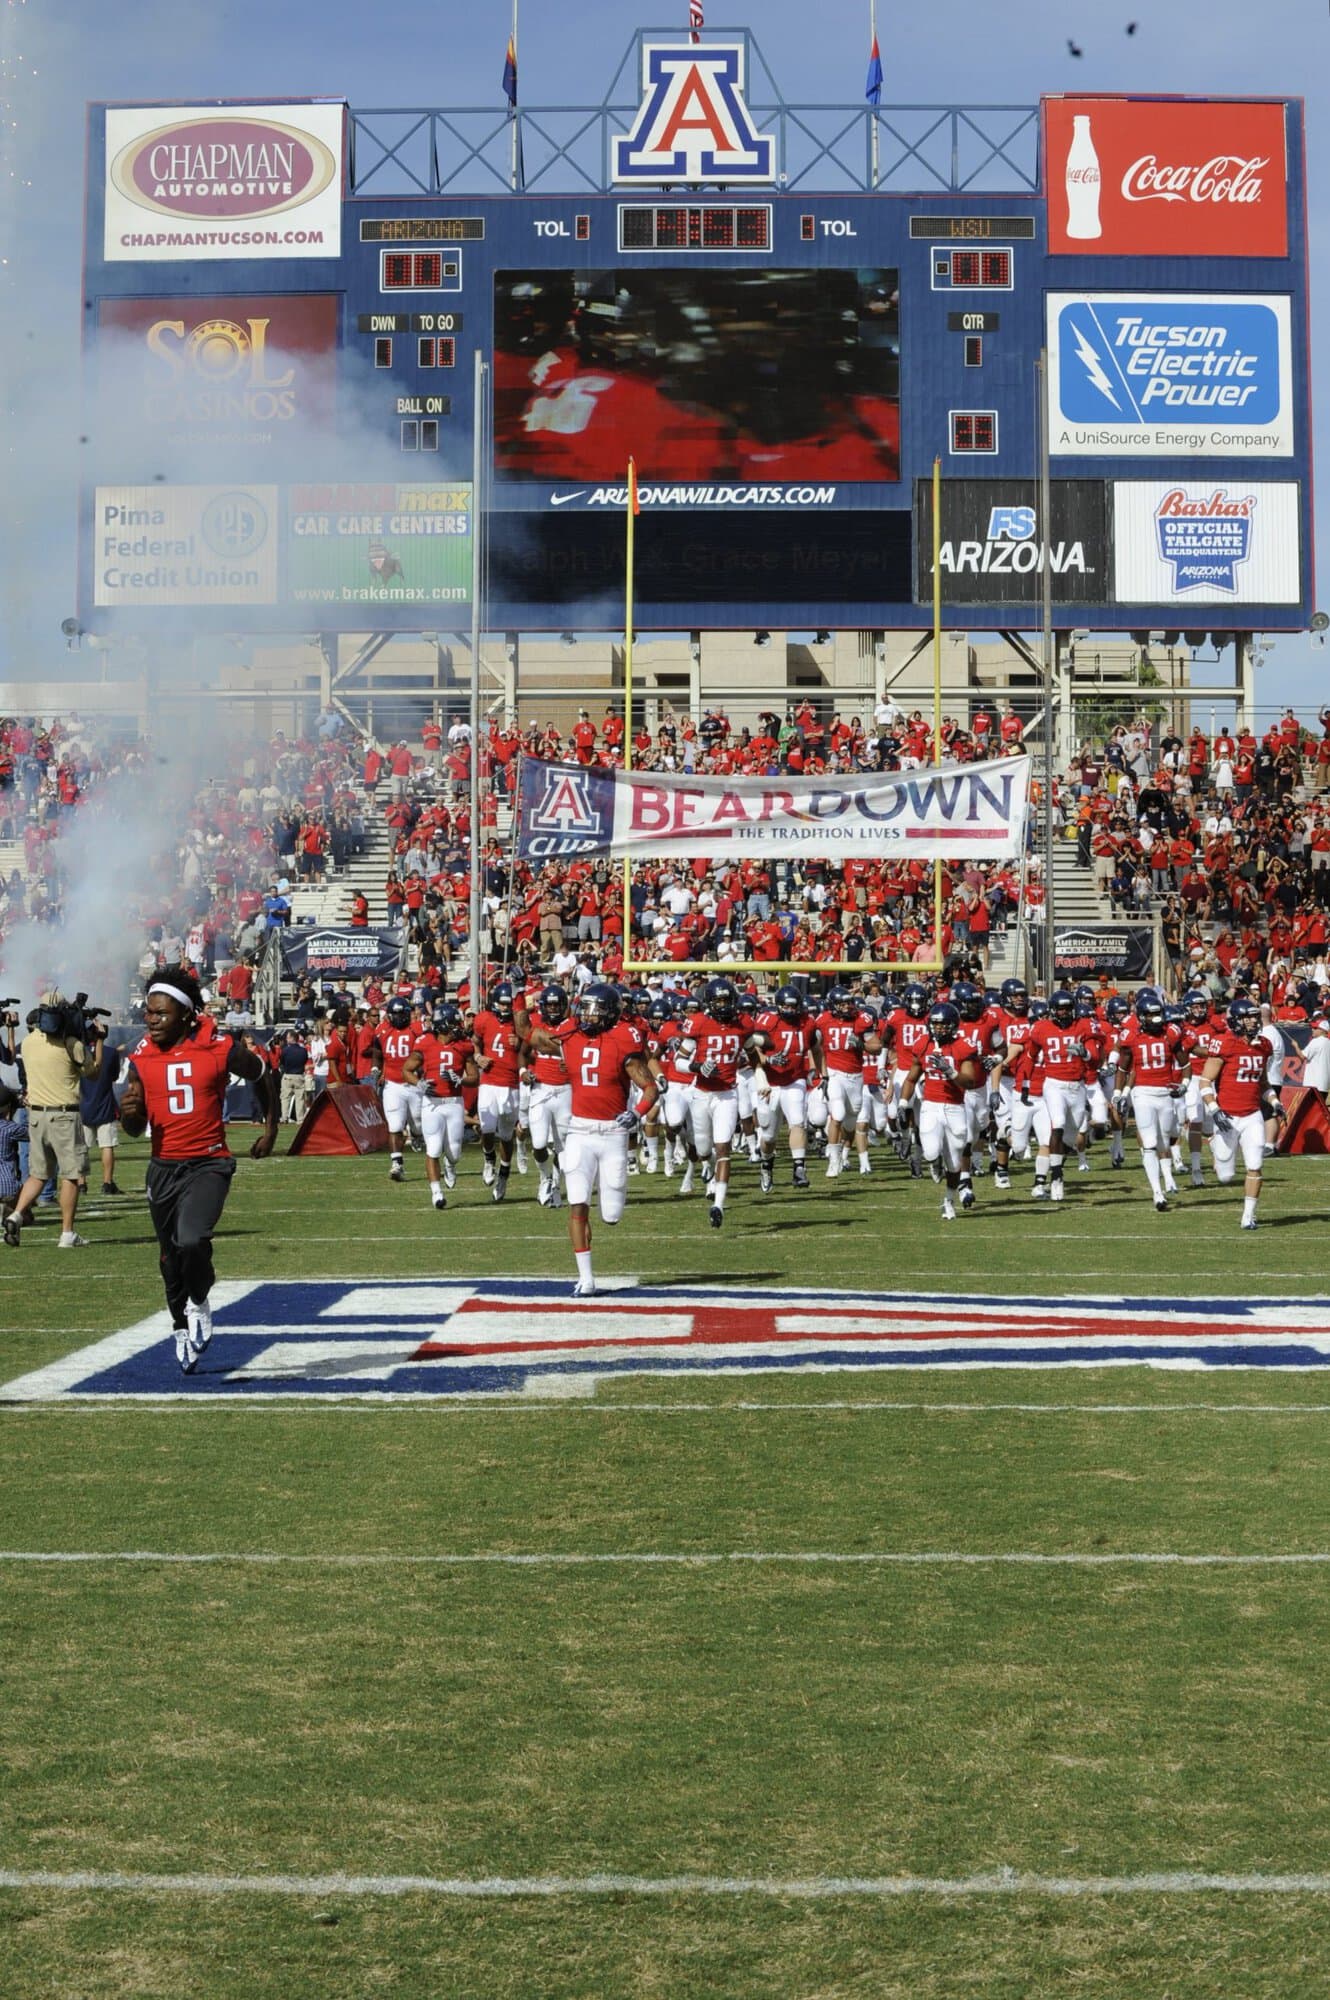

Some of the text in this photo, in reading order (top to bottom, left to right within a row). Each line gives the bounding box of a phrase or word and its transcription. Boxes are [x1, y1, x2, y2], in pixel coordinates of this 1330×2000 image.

[612, 44, 775, 182] A
[149, 143, 295, 181] CHAPMAN
[153, 181, 292, 197] AUTOMOTIVE
[1121, 155, 1270, 202] Coca-Cola
[120, 231, 324, 247] CHAPMANTUCSON.COM
[381, 221, 464, 239] ARIZONA
[534, 221, 569, 236] TOL
[577, 217, 588, 239] 3
[820, 221, 857, 236] TOL
[370, 315, 396, 331] DWN
[420, 315, 454, 330] TO GO
[962, 314, 985, 330] QTR
[1115, 317, 1227, 347] Tucson
[146, 318, 296, 388] SOL
[1127, 348, 1257, 376] Electric
[1140, 377, 1257, 406] Power
[397, 398, 442, 413] BALL ON
[1060, 432, 1280, 448] A UniSource Energy Company
[104, 505, 166, 526] Pima
[294, 515, 467, 536] CAR CARE CENTERS
[987, 506, 1036, 541] FS
[1165, 523, 1243, 534] OFFICIAL
[104, 536, 195, 557] Federal
[1165, 536, 1242, 547] TAILGATE
[1166, 548, 1242, 556] HEADQUARTERS
[930, 541, 1086, 574] ARIZONA
[103, 565, 259, 588] Credit Union
[1178, 566, 1231, 576] ARIZONA
[294, 586, 467, 600] www.brakemax.com
[530, 768, 600, 834] A
[738, 827, 900, 839] THE TRADITION LIVES
[385, 1035, 410, 1058] 46
[492, 1033, 505, 1057] 4
[707, 1035, 740, 1064] 23
[781, 1031, 804, 1056] 71
[581, 1047, 600, 1087] 2
[1138, 1042, 1166, 1070] 19
[1236, 1055, 1263, 1083] 25
[167, 1061, 194, 1115] 5
